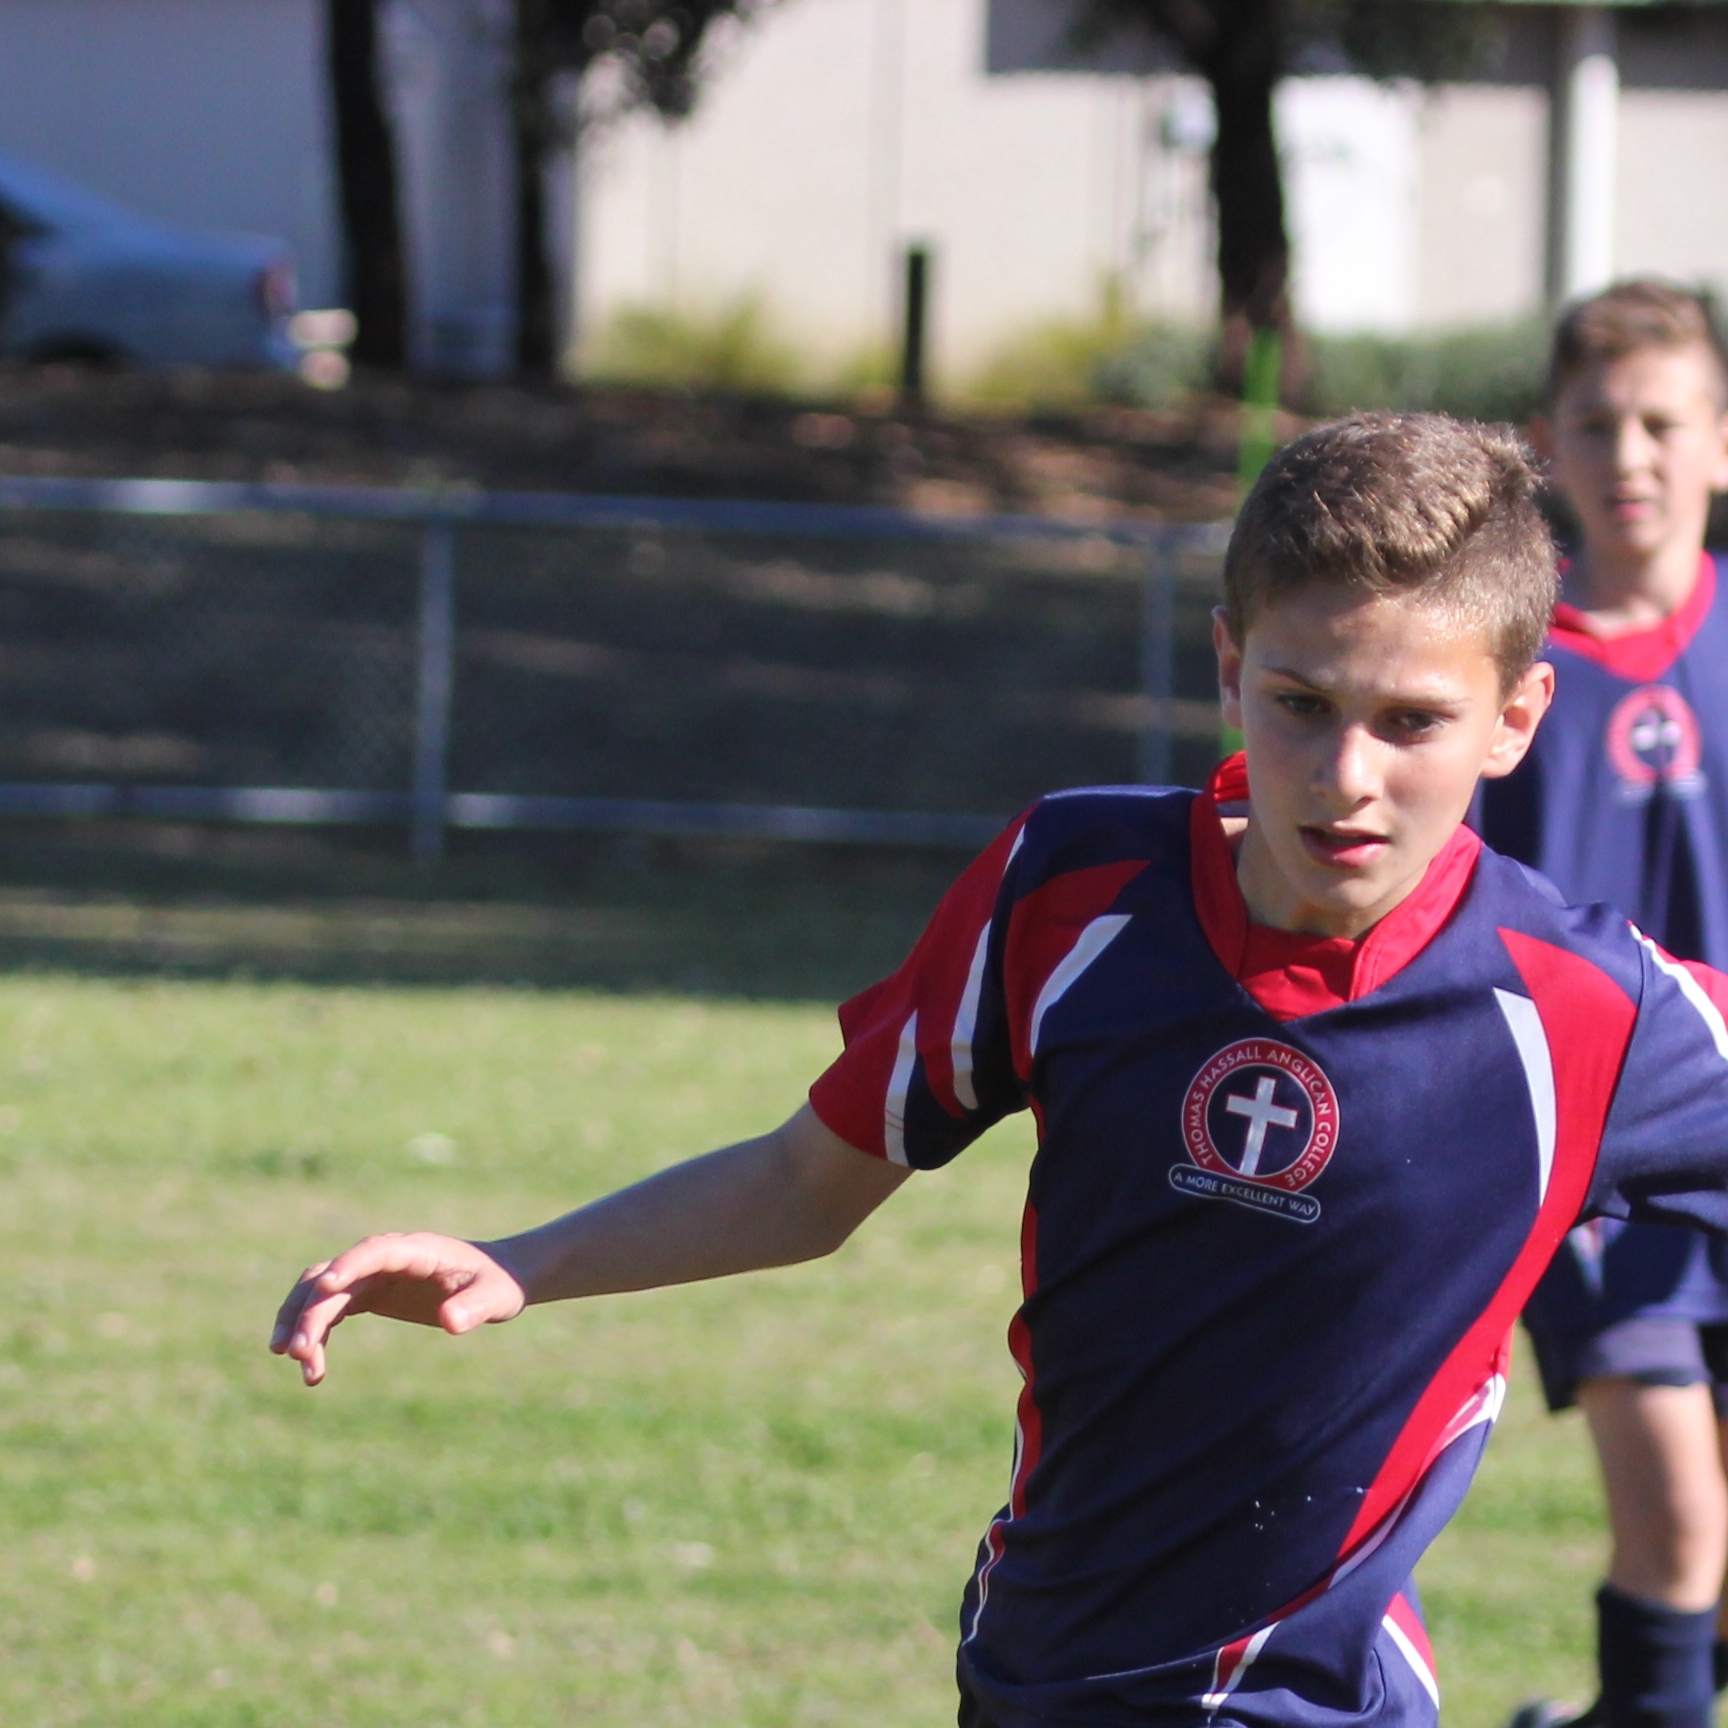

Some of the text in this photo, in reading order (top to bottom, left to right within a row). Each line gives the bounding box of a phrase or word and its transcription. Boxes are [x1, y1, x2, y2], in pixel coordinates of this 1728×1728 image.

[1190, 1045, 1332, 1187] THOMAS HASSALL ANGLICAN COLLEGE
[1173, 1172, 1316, 1216] A MORE EXCELLENT WAY
